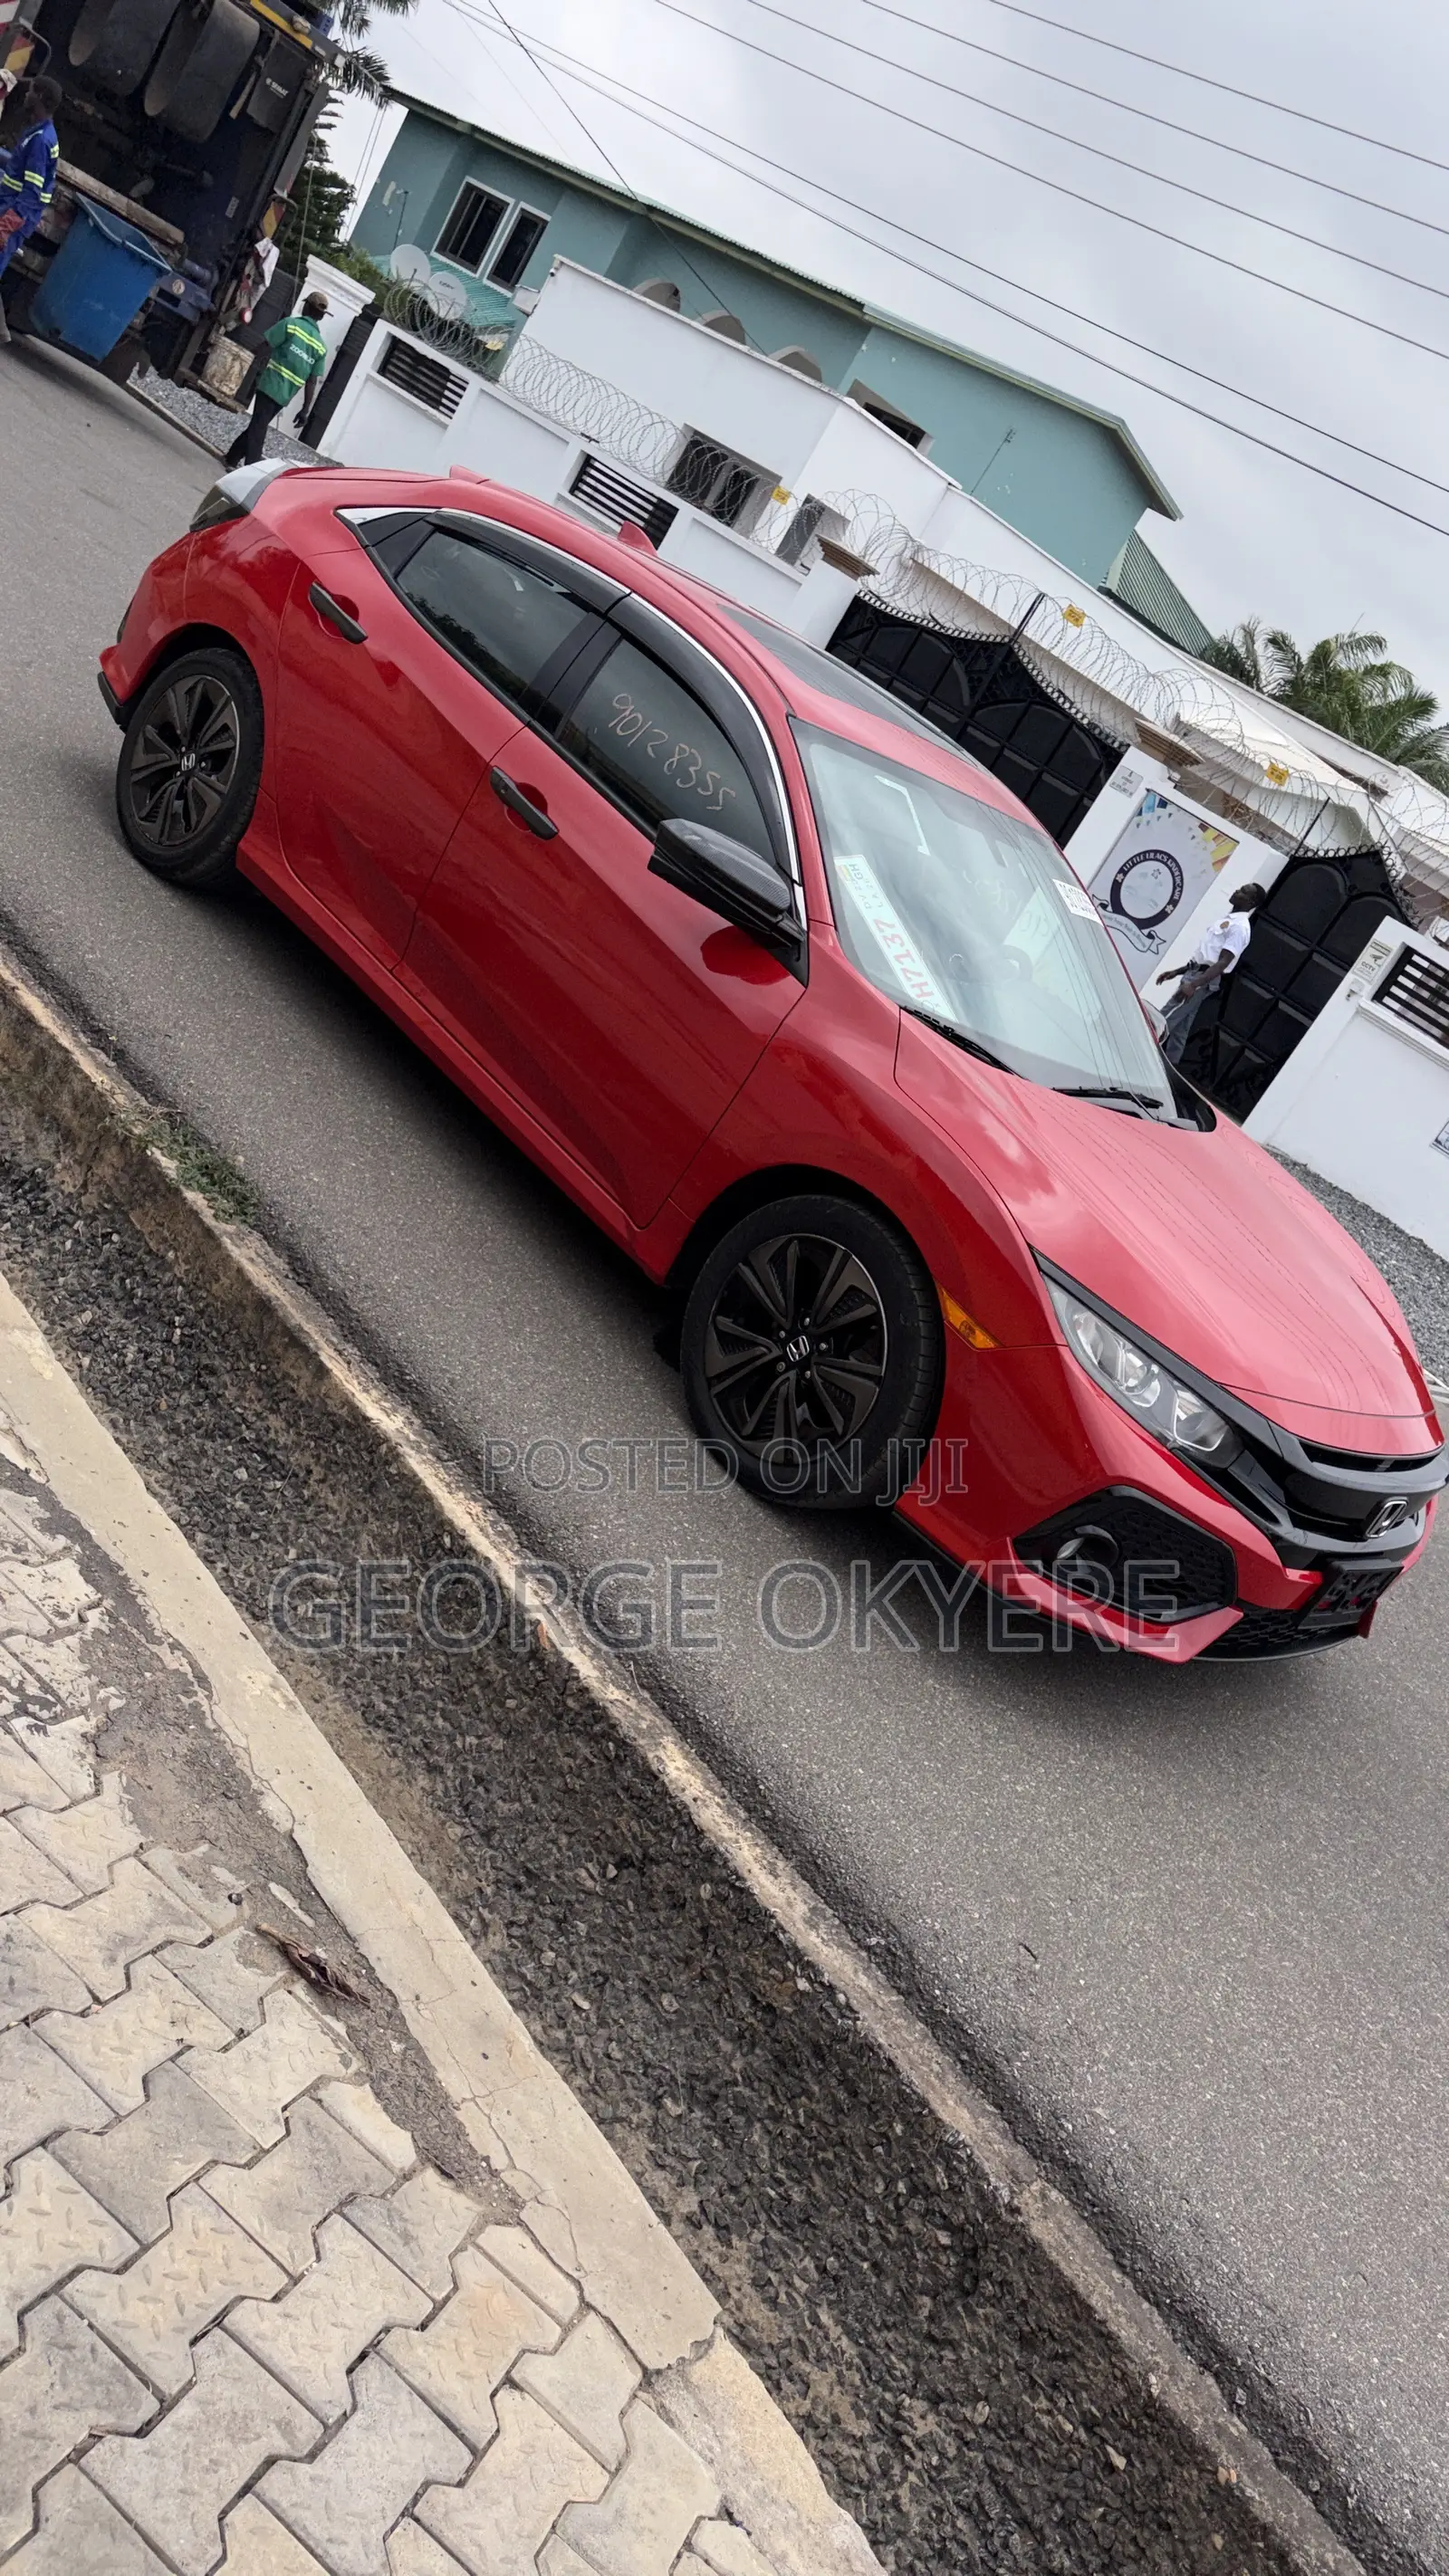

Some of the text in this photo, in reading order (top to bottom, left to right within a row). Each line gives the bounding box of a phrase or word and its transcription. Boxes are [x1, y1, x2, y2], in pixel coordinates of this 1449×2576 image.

[609, 693, 736, 811] 90128355
[1123, 853, 1146, 871] LITTLE
[1146, 852, 1169, 863] LILACS
[1361, 961, 1376, 972] CCTV
